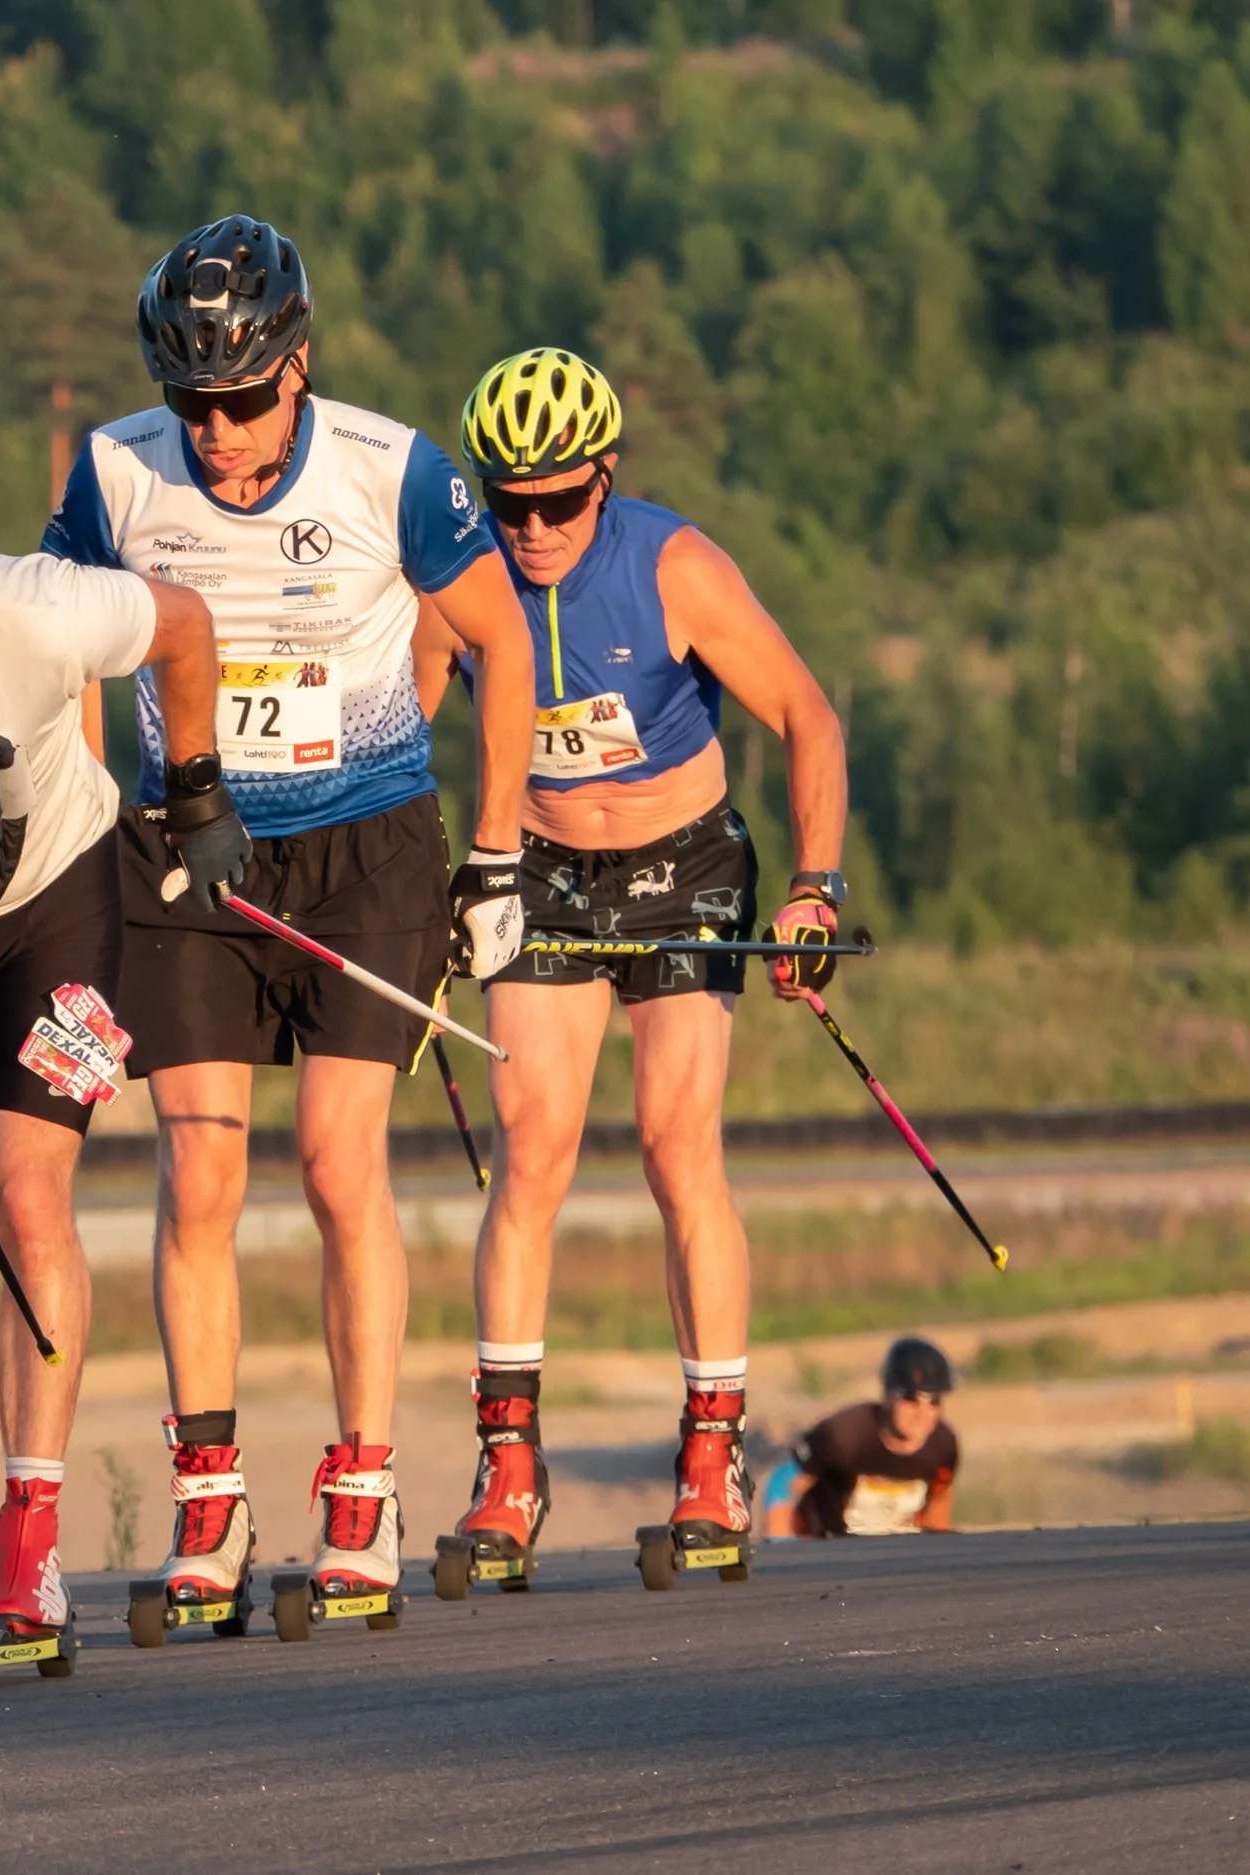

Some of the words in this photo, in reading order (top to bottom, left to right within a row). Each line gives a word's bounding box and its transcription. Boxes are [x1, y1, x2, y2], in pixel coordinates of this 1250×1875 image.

[332, 427, 391, 450] noname
[152, 538, 187, 553] Pohjan
[289, 524, 324, 561] K
[177, 568, 227, 581] Kangasalan
[284, 573, 333, 583] KANGASALA
[231, 695, 282, 738] 72
[535, 728, 585, 756] 78
[299, 746, 329, 759] renta
[36, 1022, 94, 1065] DEXAL
[334, 1479, 365, 1489] pina
